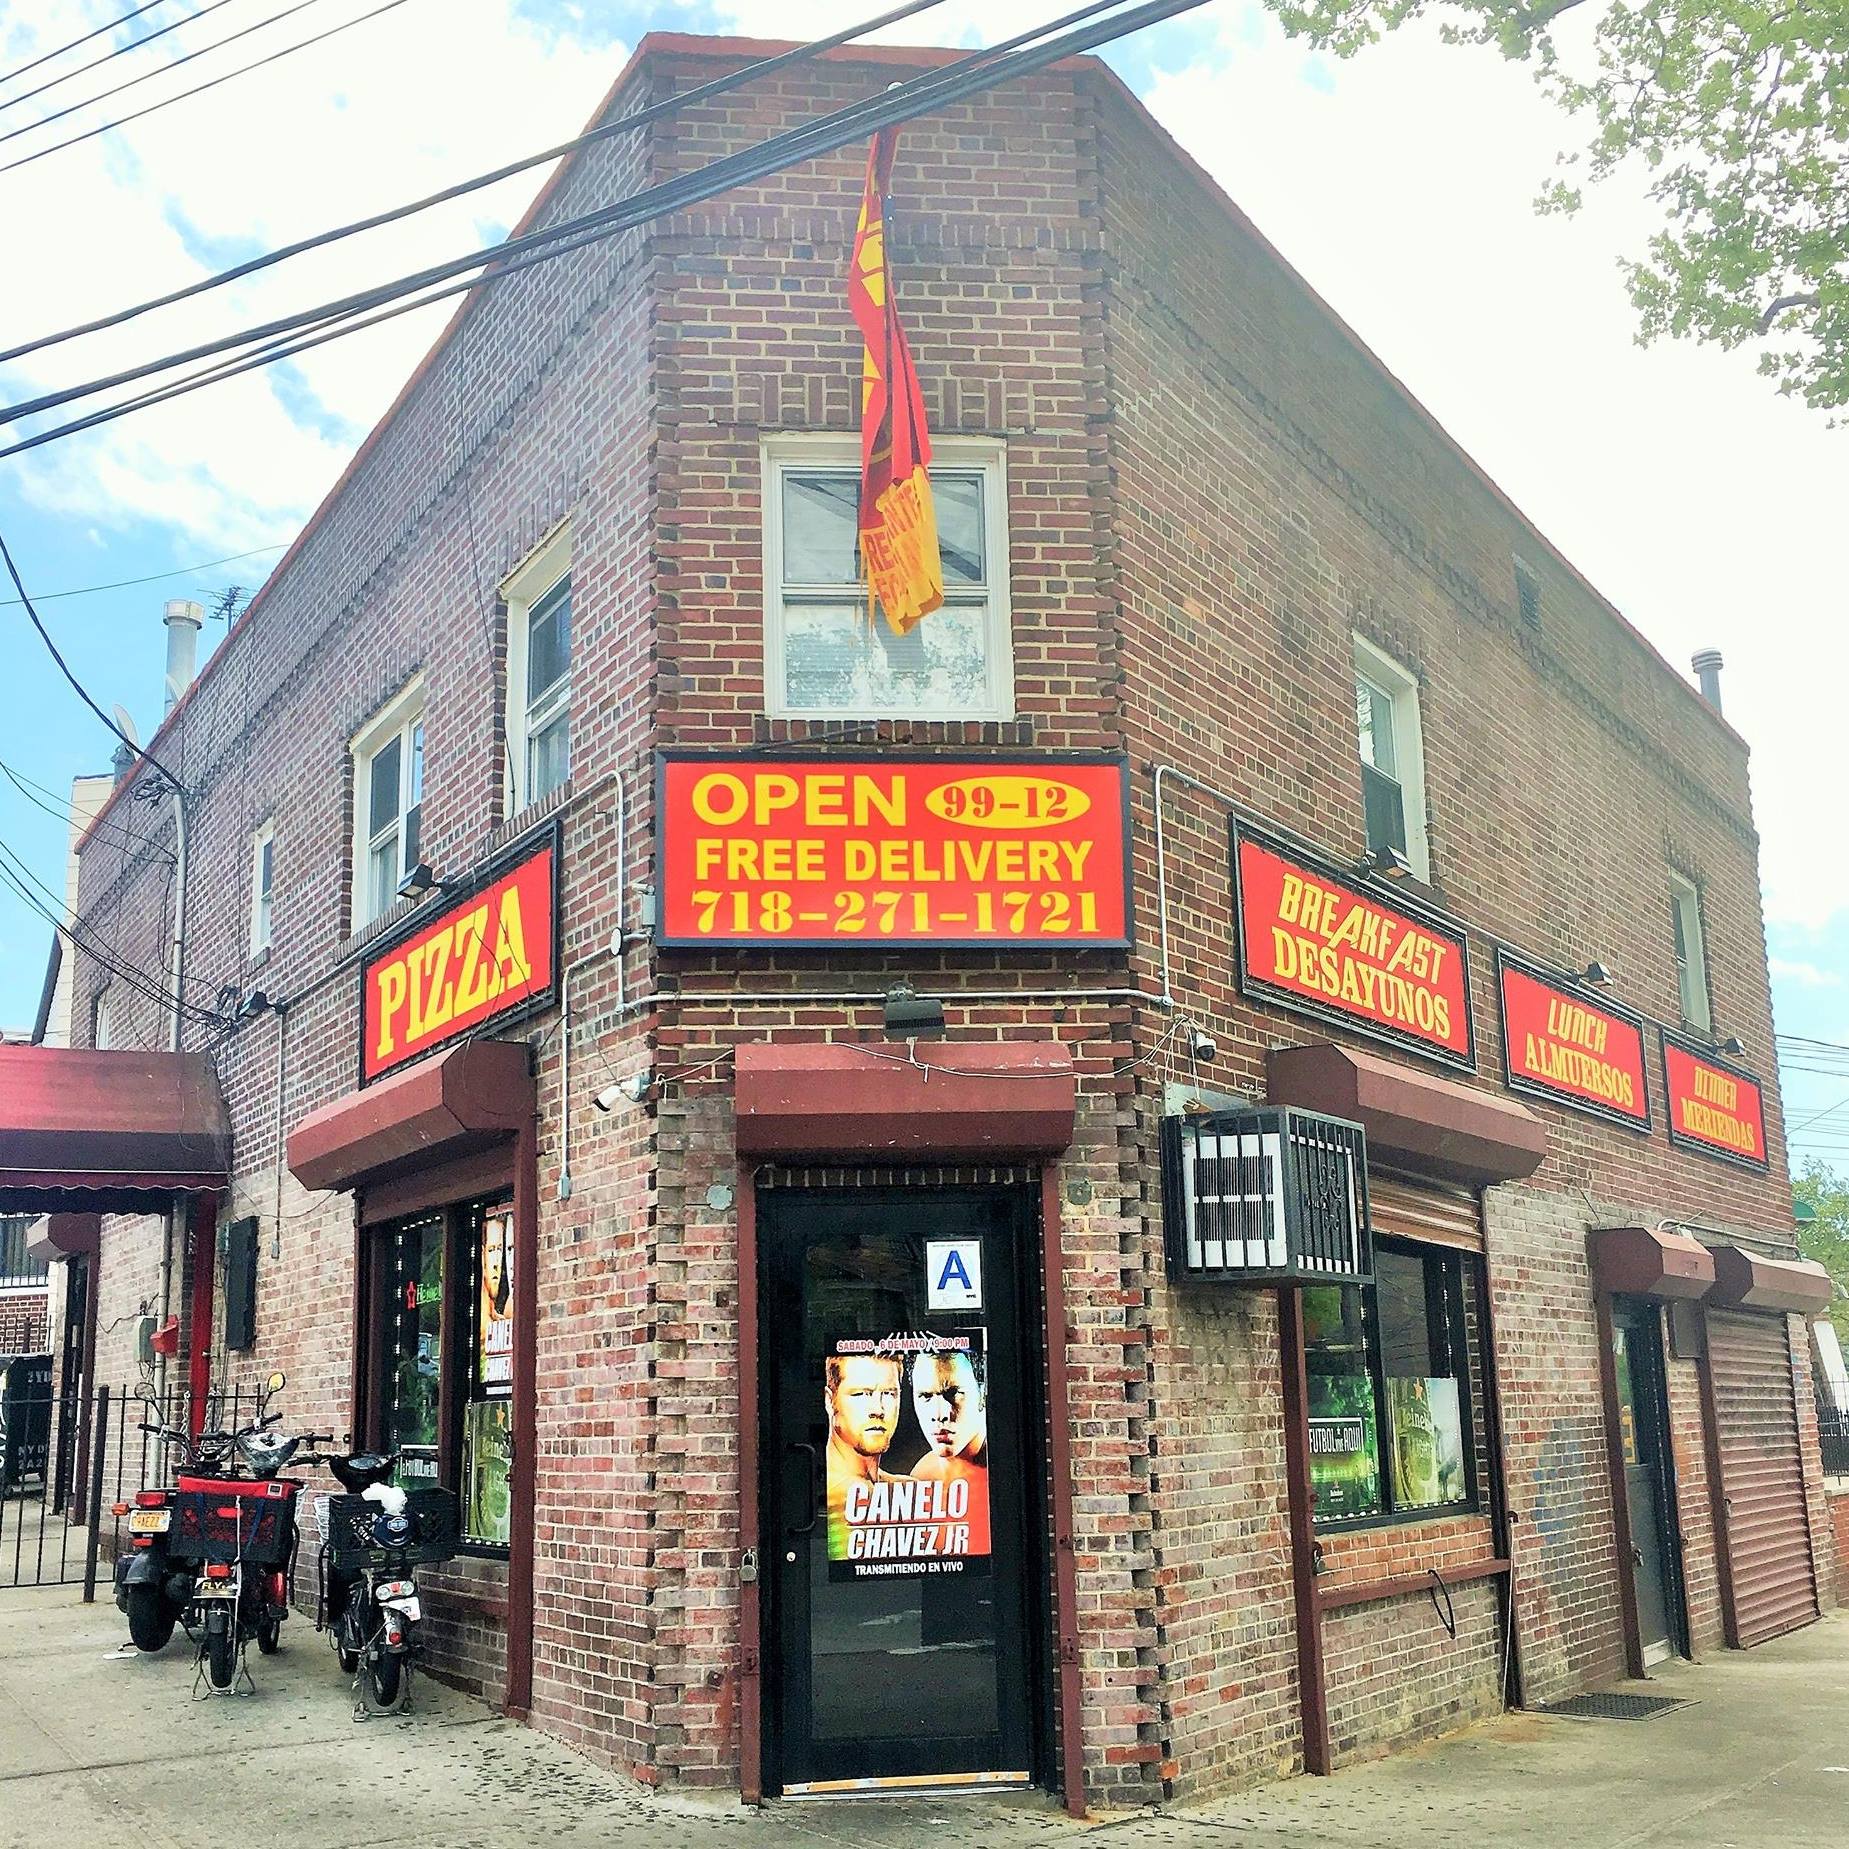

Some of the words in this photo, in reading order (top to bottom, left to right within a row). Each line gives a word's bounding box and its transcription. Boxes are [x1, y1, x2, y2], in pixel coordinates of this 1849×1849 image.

[692, 773, 906, 826] OPEN
[943, 785, 1069, 819] 99-12
[696, 838, 827, 881] FREE
[845, 839, 1093, 882] DELIVERY
[692, 889, 1101, 933] 718-271-1721
[1278, 872, 1447, 985] BREAKFAST
[376, 885, 532, 1060] PIZZA
[1271, 926, 1451, 1040] DESAYUNOS
[1547, 997, 1608, 1056] LUNCH
[1524, 1032, 1634, 1108] ALMUERSOS
[1694, 1065, 1737, 1113] DINNER
[1681, 1097, 1755, 1152] MERIENDAS
[937, 1250, 973, 1290] A
[887, 1339, 900, 1351] DE
[901, 1338, 926, 1350] MAYO
[934, 1337, 953, 1350] 9:00
[954, 1337, 969, 1350] PM
[1308, 1428, 1336, 1453] FUTBOL
[845, 1479, 969, 1522] CANELO
[848, 1527, 940, 1559] CHAVEZ
[942, 1526, 969, 1555] JR
[855, 1563, 926, 1575] TRANSMITIENDO
[928, 1563, 940, 1572] EN
[942, 1561, 963, 1572] VIVO
